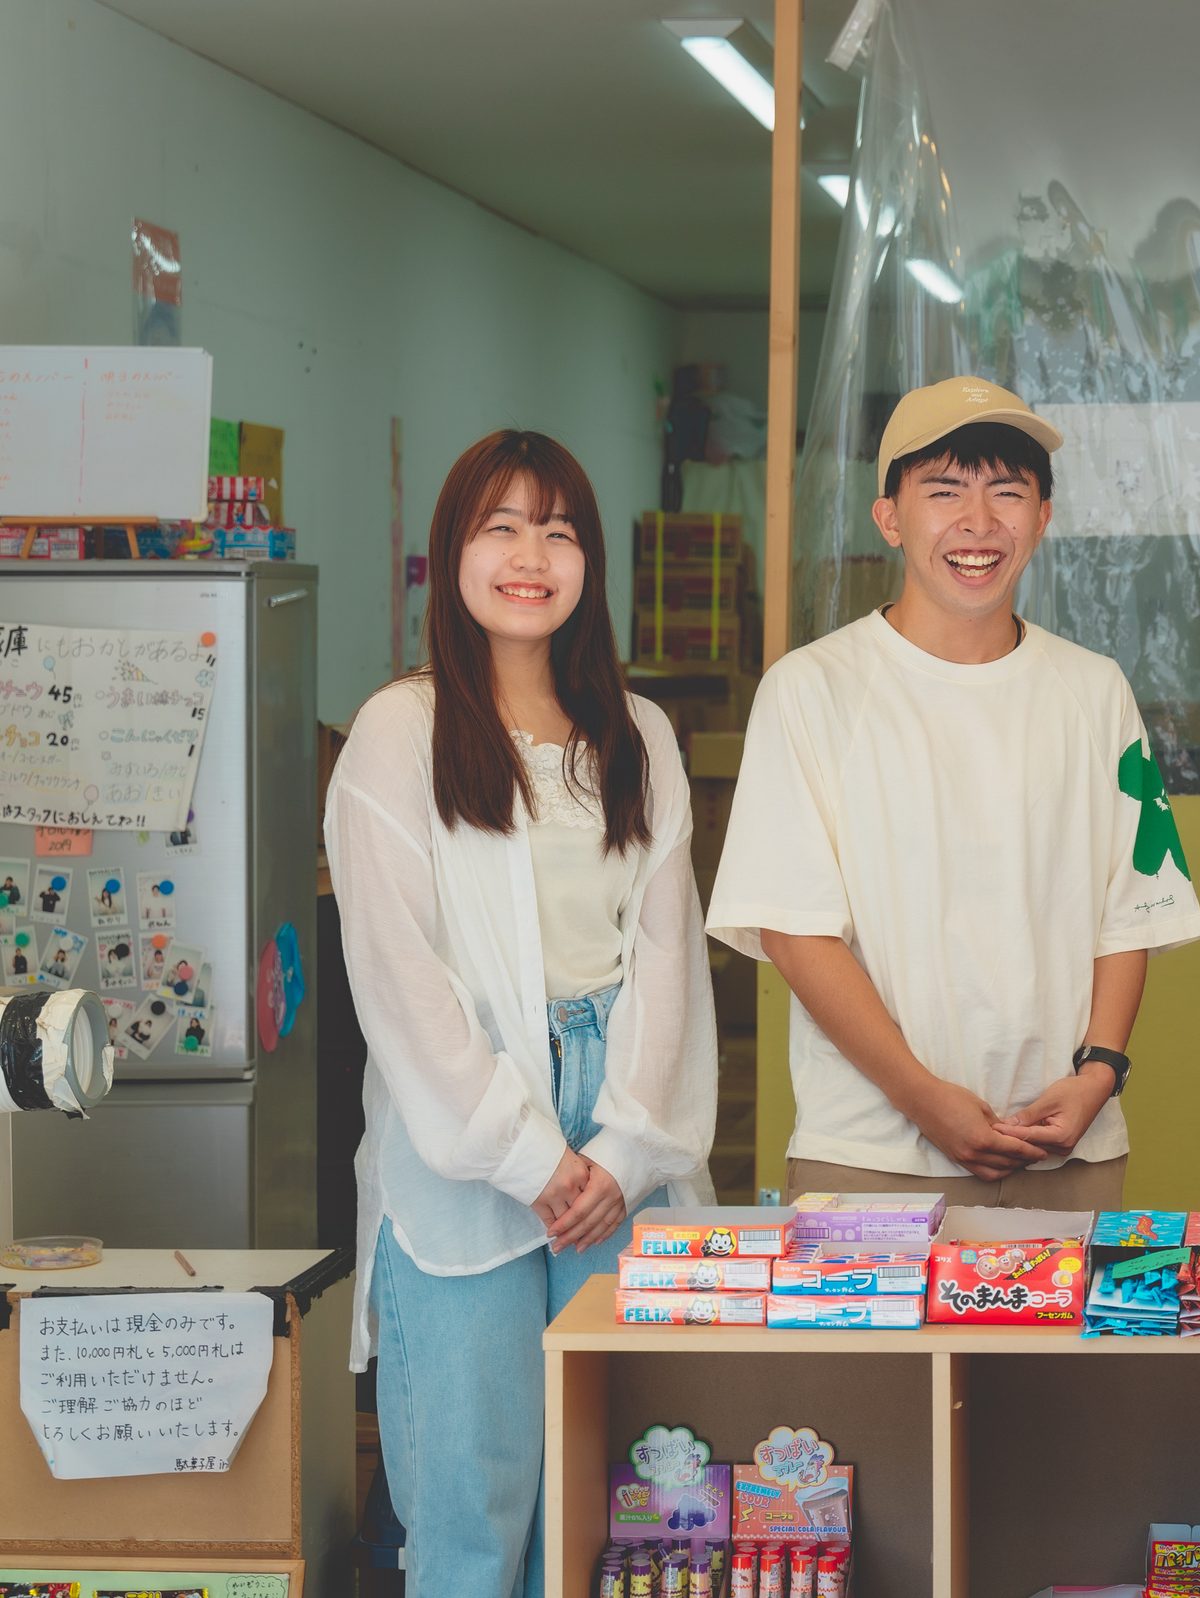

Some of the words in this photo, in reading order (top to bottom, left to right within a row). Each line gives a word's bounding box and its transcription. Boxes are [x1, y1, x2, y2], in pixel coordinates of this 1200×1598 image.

[642, 1240, 690, 1255] FELIX
[628, 1272, 677, 1288] FELIX
[801, 1268, 873, 1289] コーラ
[624, 1306, 673, 1322] FELIX
[796, 1301, 867, 1323] コーラ
[40, 1313, 235, 1336] お支払いは現金のみです。
[40, 1370, 214, 1387] ご利用いただけません。
[43, 1420, 239, 1441] よろしくお願いいたします。
[760, 1438, 819, 1464] すっぱい
